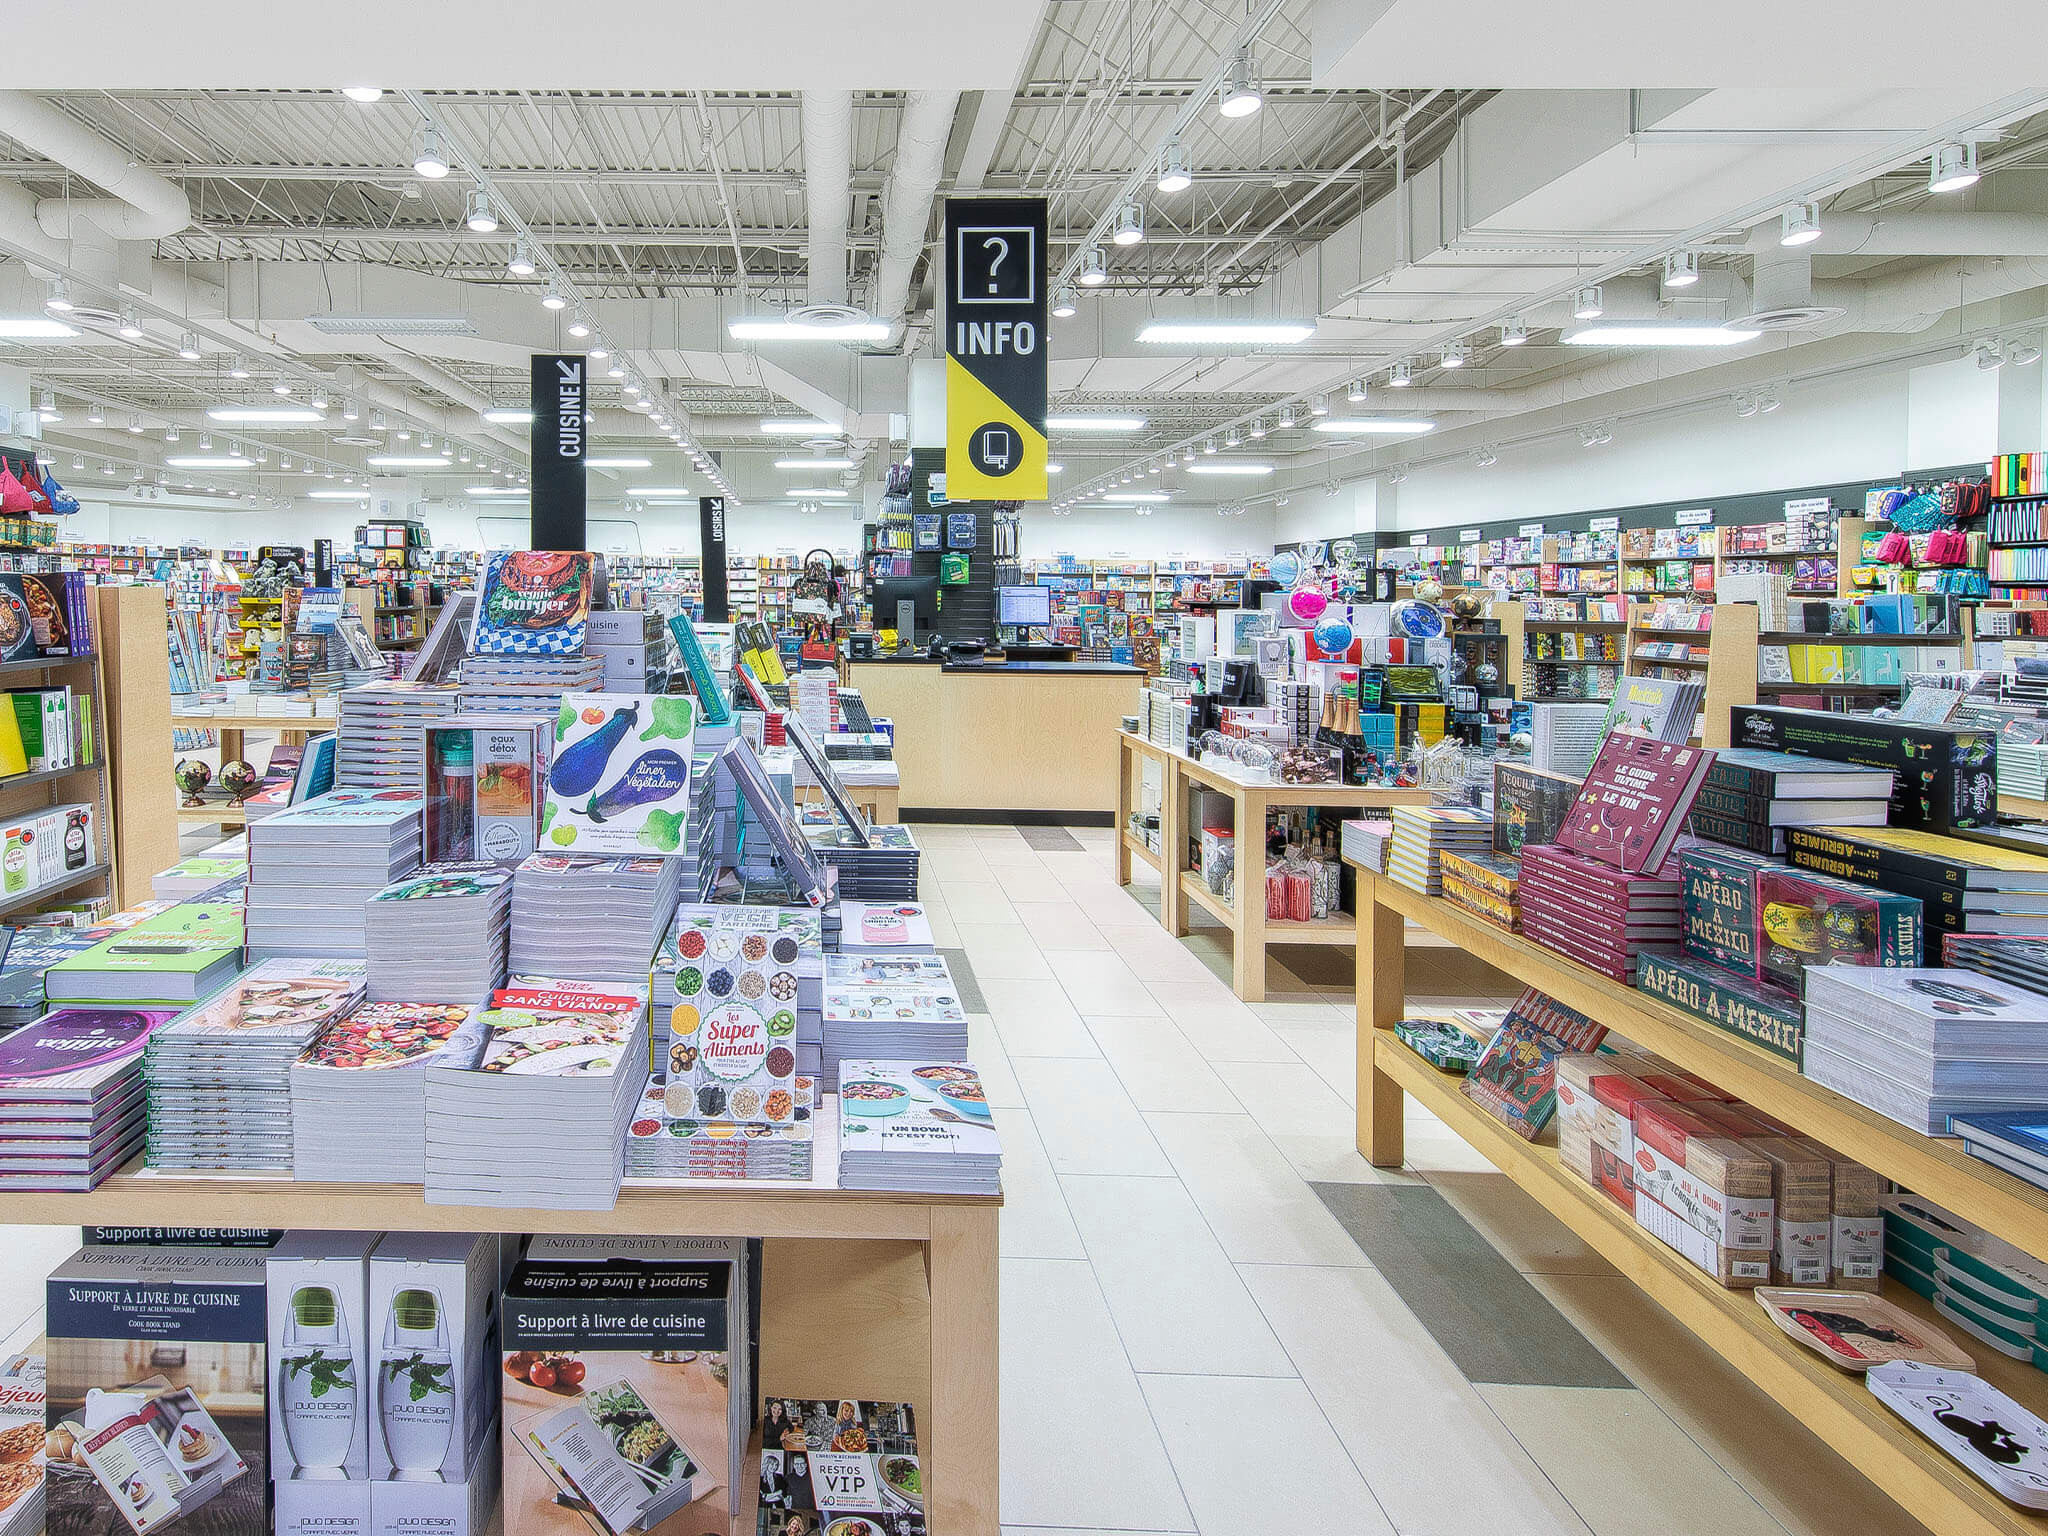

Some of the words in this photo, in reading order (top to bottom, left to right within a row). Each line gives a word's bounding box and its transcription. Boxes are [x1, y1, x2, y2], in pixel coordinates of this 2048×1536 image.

[957, 322, 1035, 355] INFO
[559, 385, 580, 457] CUISINE
[712, 510, 723, 542] LOISIRS
[501, 596, 569, 617] burger
[590, 620, 619, 630] uisine
[489, 743, 516, 752] détox
[1615, 764, 1628, 774] LE
[1629, 767, 1658, 782] GUIDE
[624, 774, 680, 792] Végétalien
[1502, 771, 1536, 792] TEQUILA
[1614, 774, 1650, 791] ULTIME
[1601, 791, 1619, 805] LE
[1619, 794, 1641, 811] VIN
[1793, 831, 1854, 858] AGRUMES
[1460, 860, 1486, 882] TEQUILA
[1794, 850, 1854, 878] AGRUMES
[1461, 884, 1488, 907] TEQUILA
[1692, 877, 1742, 910] APÉRO
[1691, 916, 1750, 954] MEXICO
[1645, 964, 1700, 1010] APÉRO
[502, 995, 551, 1007] SANS
[556, 1000, 628, 1011] VIANDE
[537, 992, 604, 1002] Cuisiner
[727, 1012, 739, 1024] Les
[708, 1020, 759, 1044] Super
[34, 1038, 126, 1052] veggie
[704, 1042, 764, 1059] Aliments
[718, 1139, 737, 1147] Super
[717, 1149, 736, 1157] Super
[717, 1159, 736, 1168] Super
[716, 1170, 736, 1178] Super
[1681, 1179, 1691, 1194] JEU
[1702, 1193, 1722, 1214] BOIRE
[96, 1227, 151, 1241] Support
[167, 1228, 196, 1238] livre
[200, 1228, 217, 1238] de
[220, 1228, 269, 1237] cuisine
[543, 1238, 594, 1249] CUISINE
[599, 1239, 616, 1249] DE
[621, 1239, 656, 1249] LIVRE
[673, 1239, 730, 1250] SUPPORT
[77, 1252, 138, 1265] SUPPORT
[153, 1256, 192, 1266] LIVRE
[193, 1257, 212, 1267] DE
[524, 1278, 576, 1289] cuisine
[580, 1278, 599, 1289] de
[603, 1278, 633, 1289] livre
[638, 1278, 646, 1289] à
[649, 1275, 709, 1289] Support
[69, 1288, 121, 1304] SUPPORT
[124, 1290, 133, 1304] À
[136, 1291, 170, 1305] LIVRE
[174, 1293, 189, 1305] DE
[193, 1293, 241, 1306] CUISINE
[128, 1320, 144, 1328] COOK
[162, 1321, 181, 1329] STAND
[517, 1314, 577, 1331] Support
[581, 1314, 590, 1328] à
[595, 1314, 626, 1328] livre
[630, 1314, 648, 1328] de
[652, 1314, 706, 1328] cuisine
[296, 1402, 315, 1410] DUO
[318, 1402, 352, 1410] DESIGN
[394, 1405, 413, 1413] DUO
[416, 1406, 450, 1414] DESIGN
[820, 1465, 861, 1474] RESTOS
[825, 1476, 866, 1493] VIP
[821, 1496, 835, 1506] 40
[325, 1518, 359, 1526] DESIGN
[399, 1518, 419, 1526] DUO
[421, 1518, 456, 1526] DESIGN
